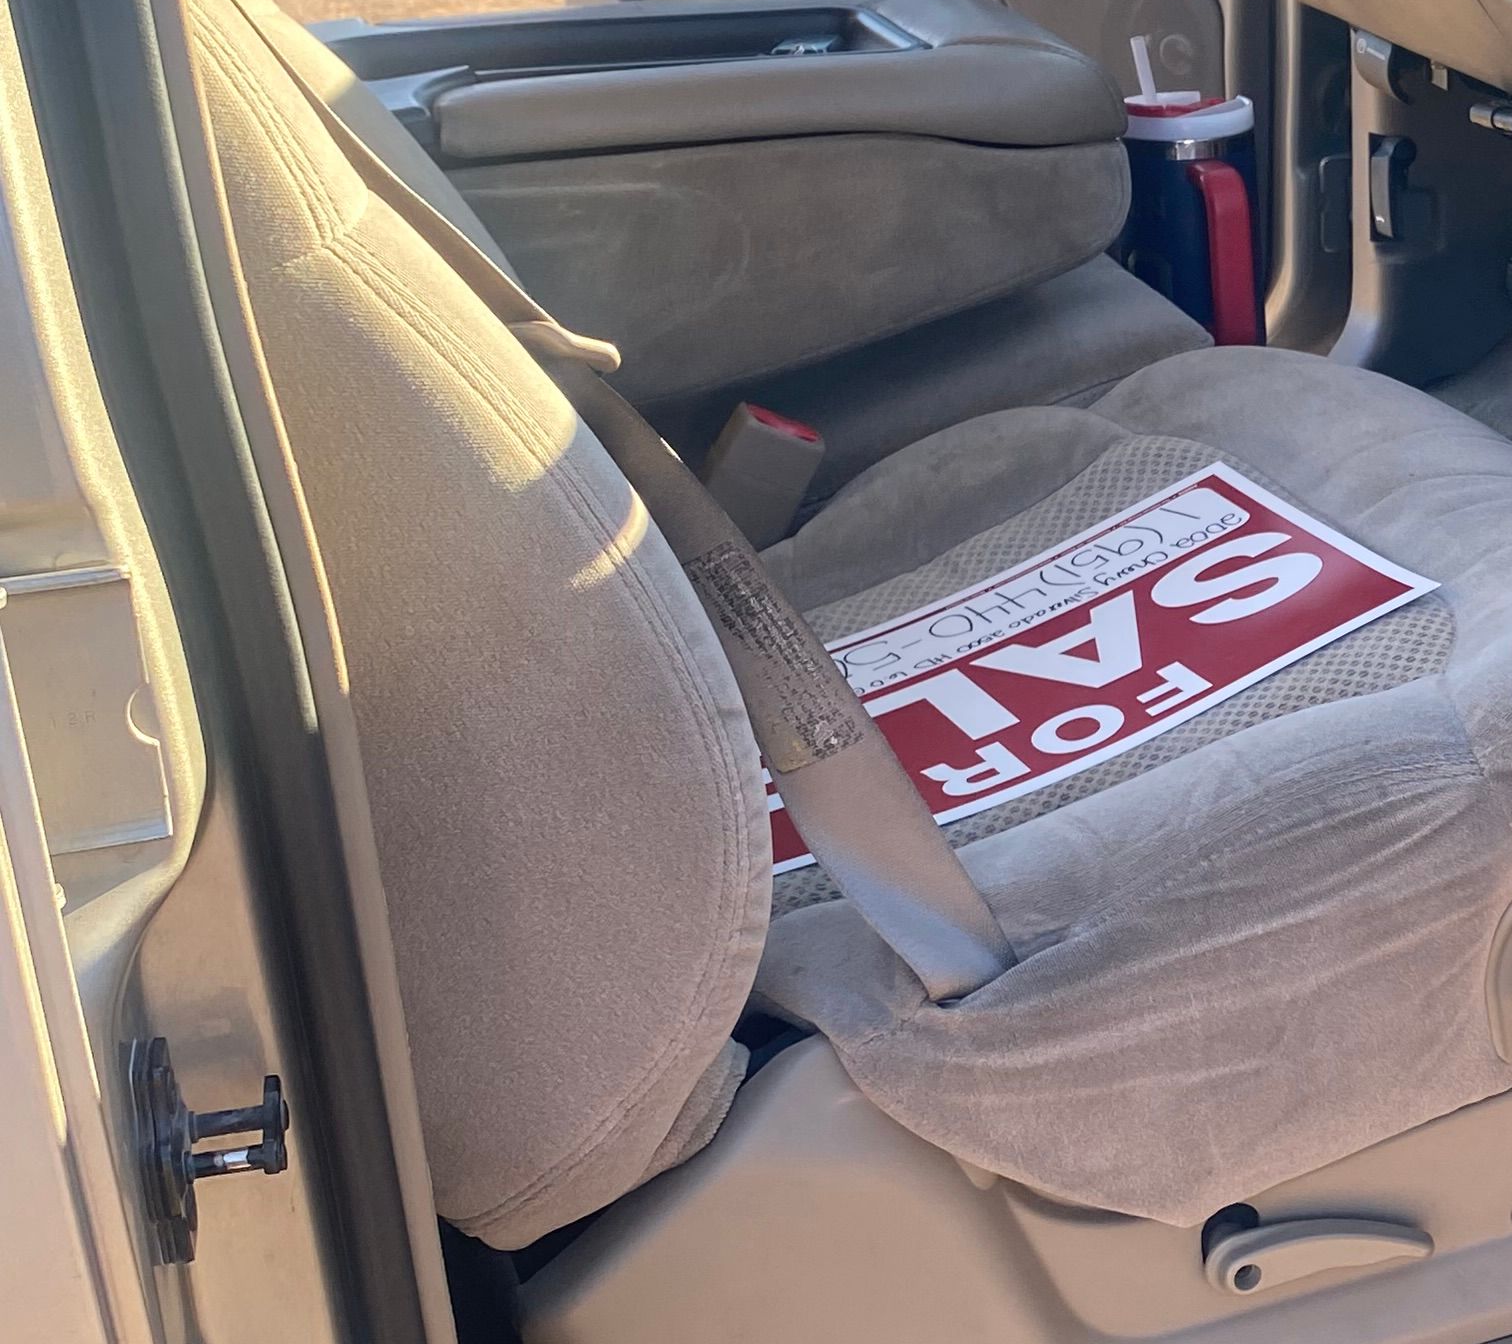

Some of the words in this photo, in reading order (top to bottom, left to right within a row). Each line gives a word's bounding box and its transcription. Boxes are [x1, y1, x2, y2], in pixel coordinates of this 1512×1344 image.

[1169, 513, 1243, 549] 2002
[1093, 550, 1169, 587] Chevy
[1008, 586, 1099, 629] Silverado
[956, 629, 1006, 653] 2500
[761, 532, 1324, 812] SAL
[913, 653, 952, 669] HD
[920, 661, 1213, 797] FOR
